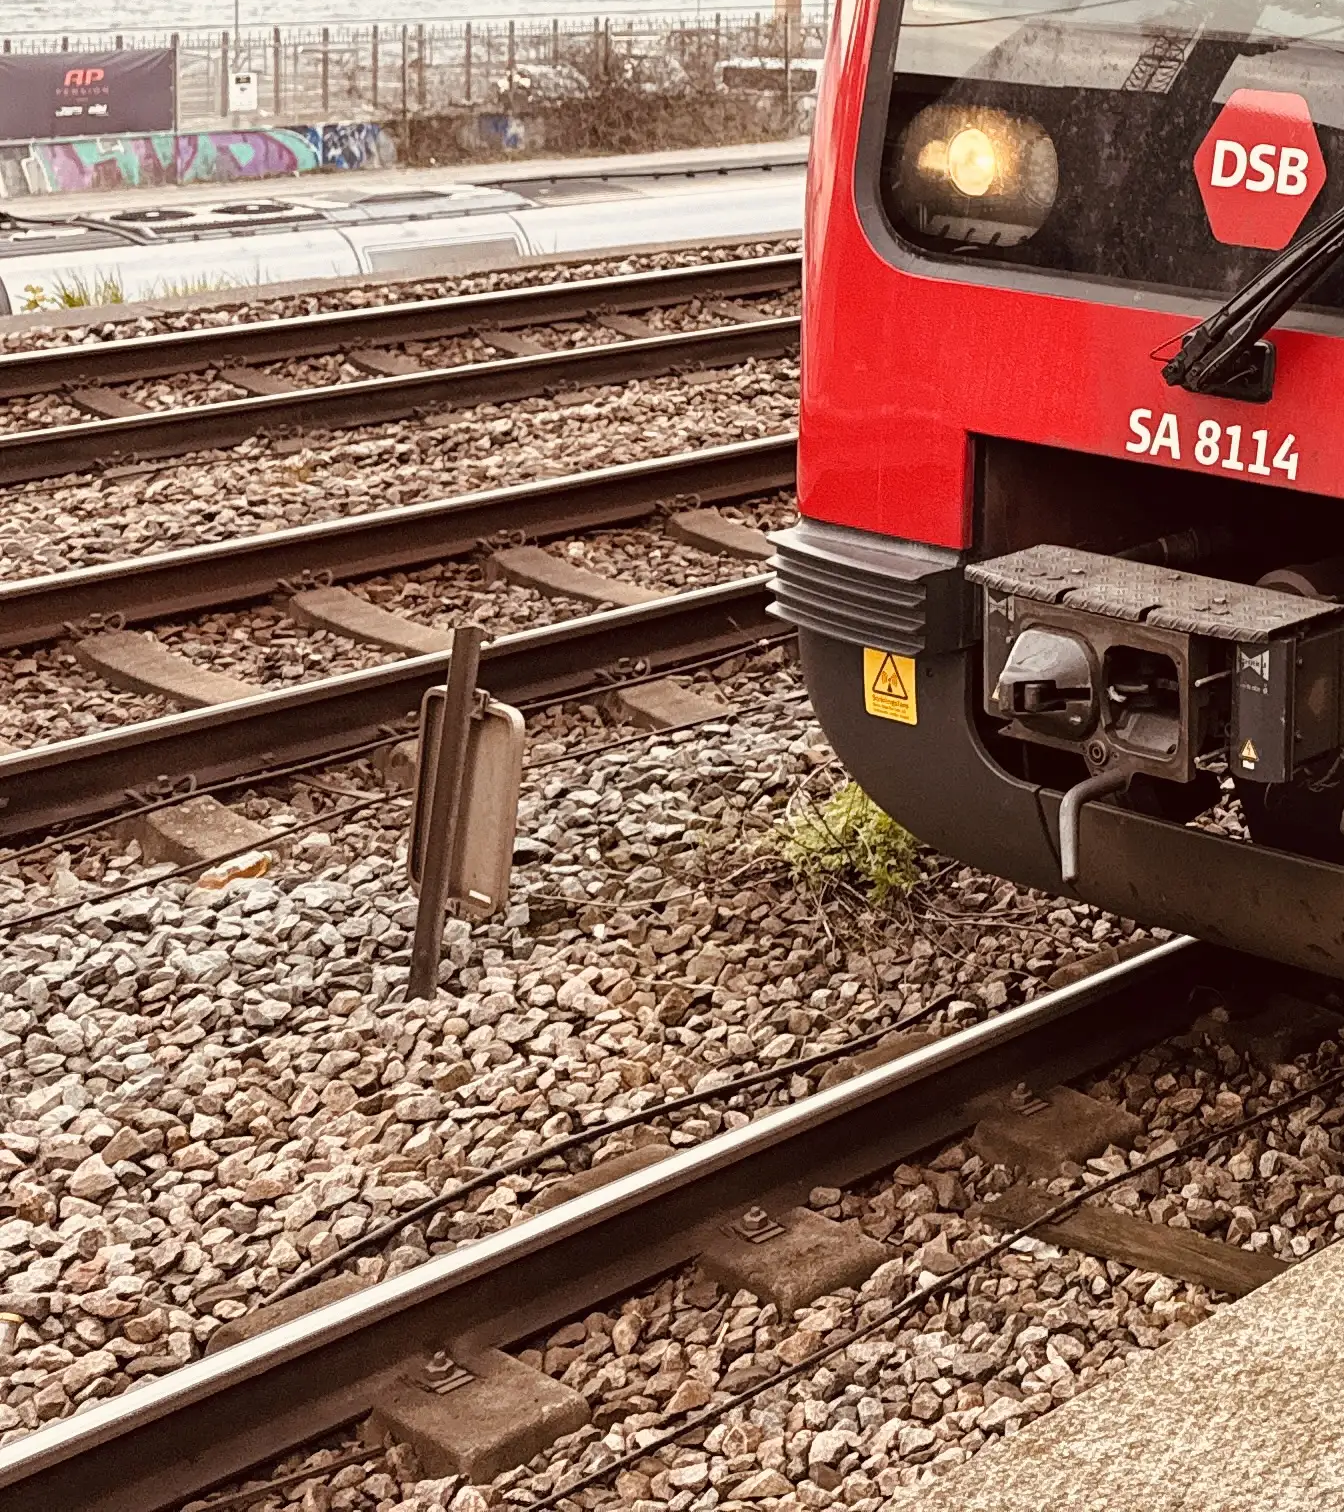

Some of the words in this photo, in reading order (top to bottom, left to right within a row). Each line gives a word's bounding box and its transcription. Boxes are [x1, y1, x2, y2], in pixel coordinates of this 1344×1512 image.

[64, 68, 105, 87] AP
[1209, 139, 1309, 196] DSB
[1125, 407, 1181, 461] SA
[1194, 419, 1301, 482] 8114
